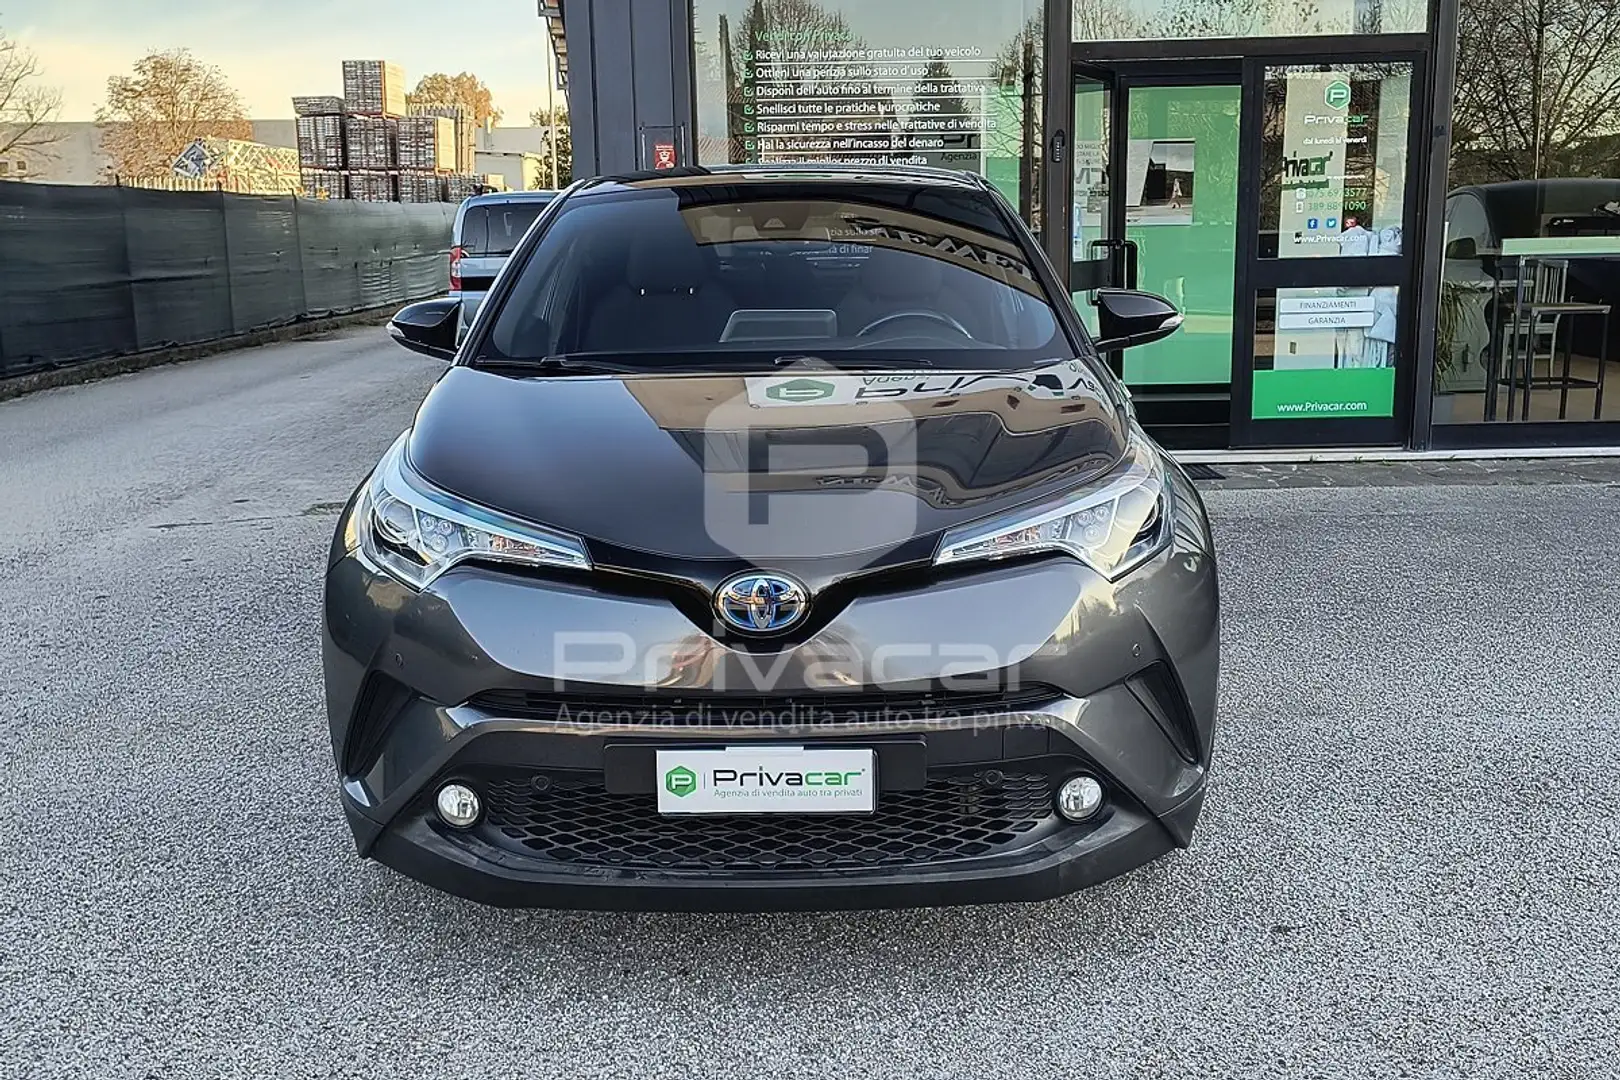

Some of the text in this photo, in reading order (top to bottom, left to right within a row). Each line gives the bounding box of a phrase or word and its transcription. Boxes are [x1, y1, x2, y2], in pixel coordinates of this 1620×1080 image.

[755, 46, 982, 60] Ricevi una valutazione gratuita del tuo veicolo
[755, 64, 929, 80] Ottieni una perizia sullo stato d'uso
[756, 82, 986, 98] Disponi dell'auto fino al termine della trattativa
[757, 101, 941, 115] Snellisci tutte le pratiche burocratiche
[757, 117, 997, 133] Risparmi tempo e stress nelle trattative di vendita
[1304, 114, 1369, 125] Privacar
[757, 136, 945, 150] Hai la sicurezza nell'incasso del denaro
[879, 155, 889, 165] di
[889, 154, 928, 165] vendita
[940, 152, 977, 163] Agenzia
[1299, 300, 1357, 309] FINANZIAMENTI
[1308, 317, 1346, 325] GARANZIA
[1277, 401, 1368, 413] www.Privacar.com
[713, 765, 863, 787] Privacar
[713, 787, 863, 799] Agenzia di vendita auto tra privati
